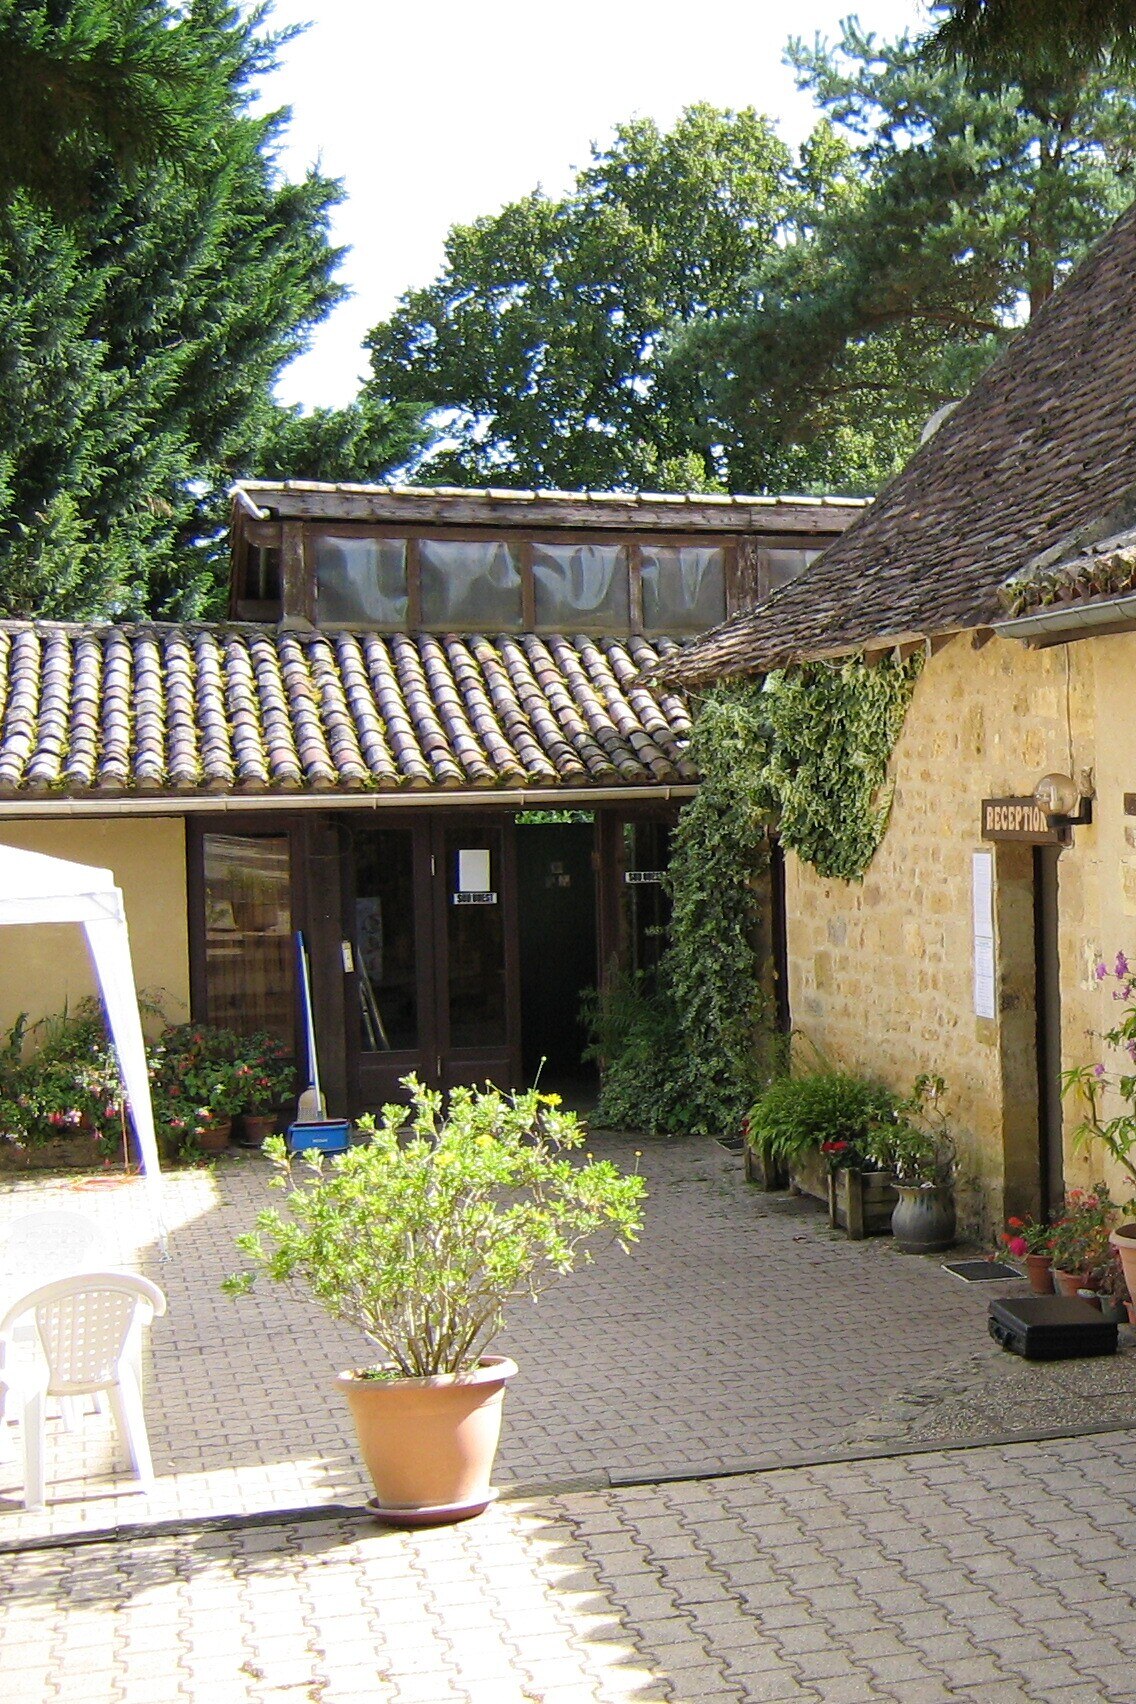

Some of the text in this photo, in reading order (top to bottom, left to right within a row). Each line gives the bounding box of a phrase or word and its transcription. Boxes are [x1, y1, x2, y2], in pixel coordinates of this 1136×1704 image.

[986, 805, 1049, 832] RECEPTION
[457, 893, 493, 902] SUD OUEST
